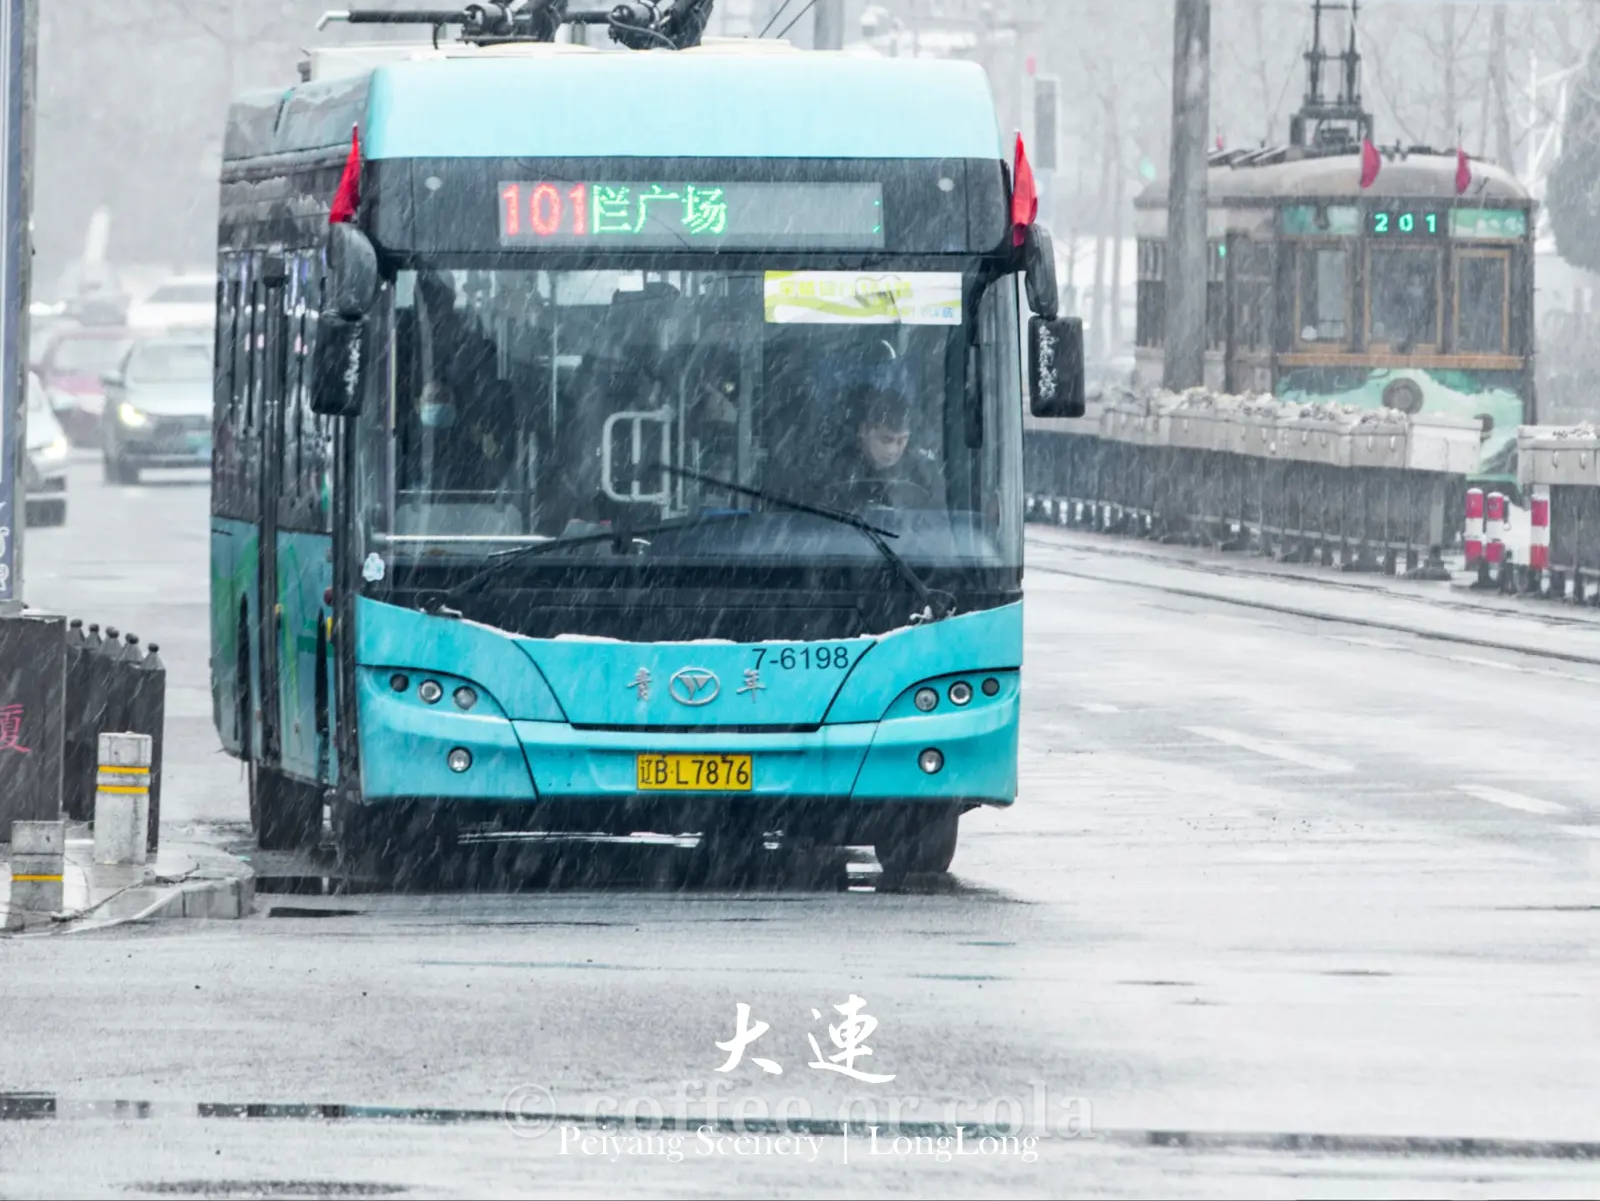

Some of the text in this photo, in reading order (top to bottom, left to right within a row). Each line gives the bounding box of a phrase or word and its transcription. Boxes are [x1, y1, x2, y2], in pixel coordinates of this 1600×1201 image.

[502, 183, 585, 236] 101
[1374, 212, 1437, 233] 201
[752, 647, 849, 670] 7-6198
